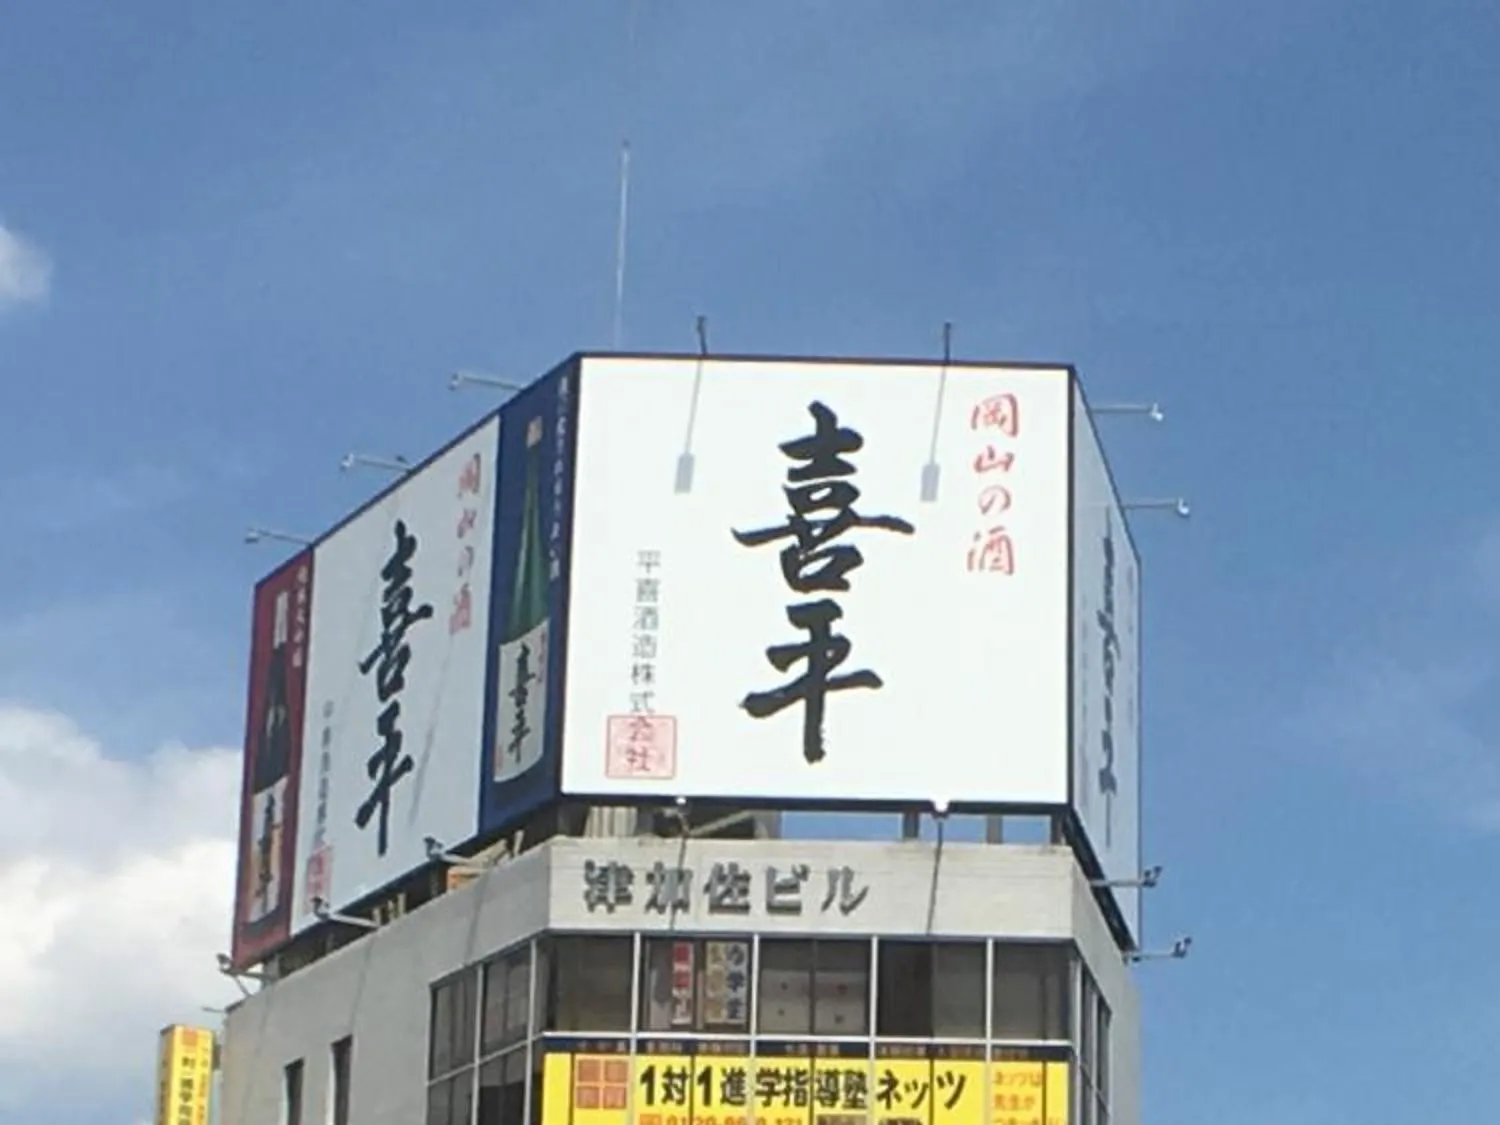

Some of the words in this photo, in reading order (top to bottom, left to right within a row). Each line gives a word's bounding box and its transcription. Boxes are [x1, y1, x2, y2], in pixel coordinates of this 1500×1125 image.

[730, 400, 916, 764] 喜平
[966, 392, 1019, 576] 岡山の酒
[355, 520, 434, 857] 喜平
[583, 859, 870, 916] 津加佐ビル
